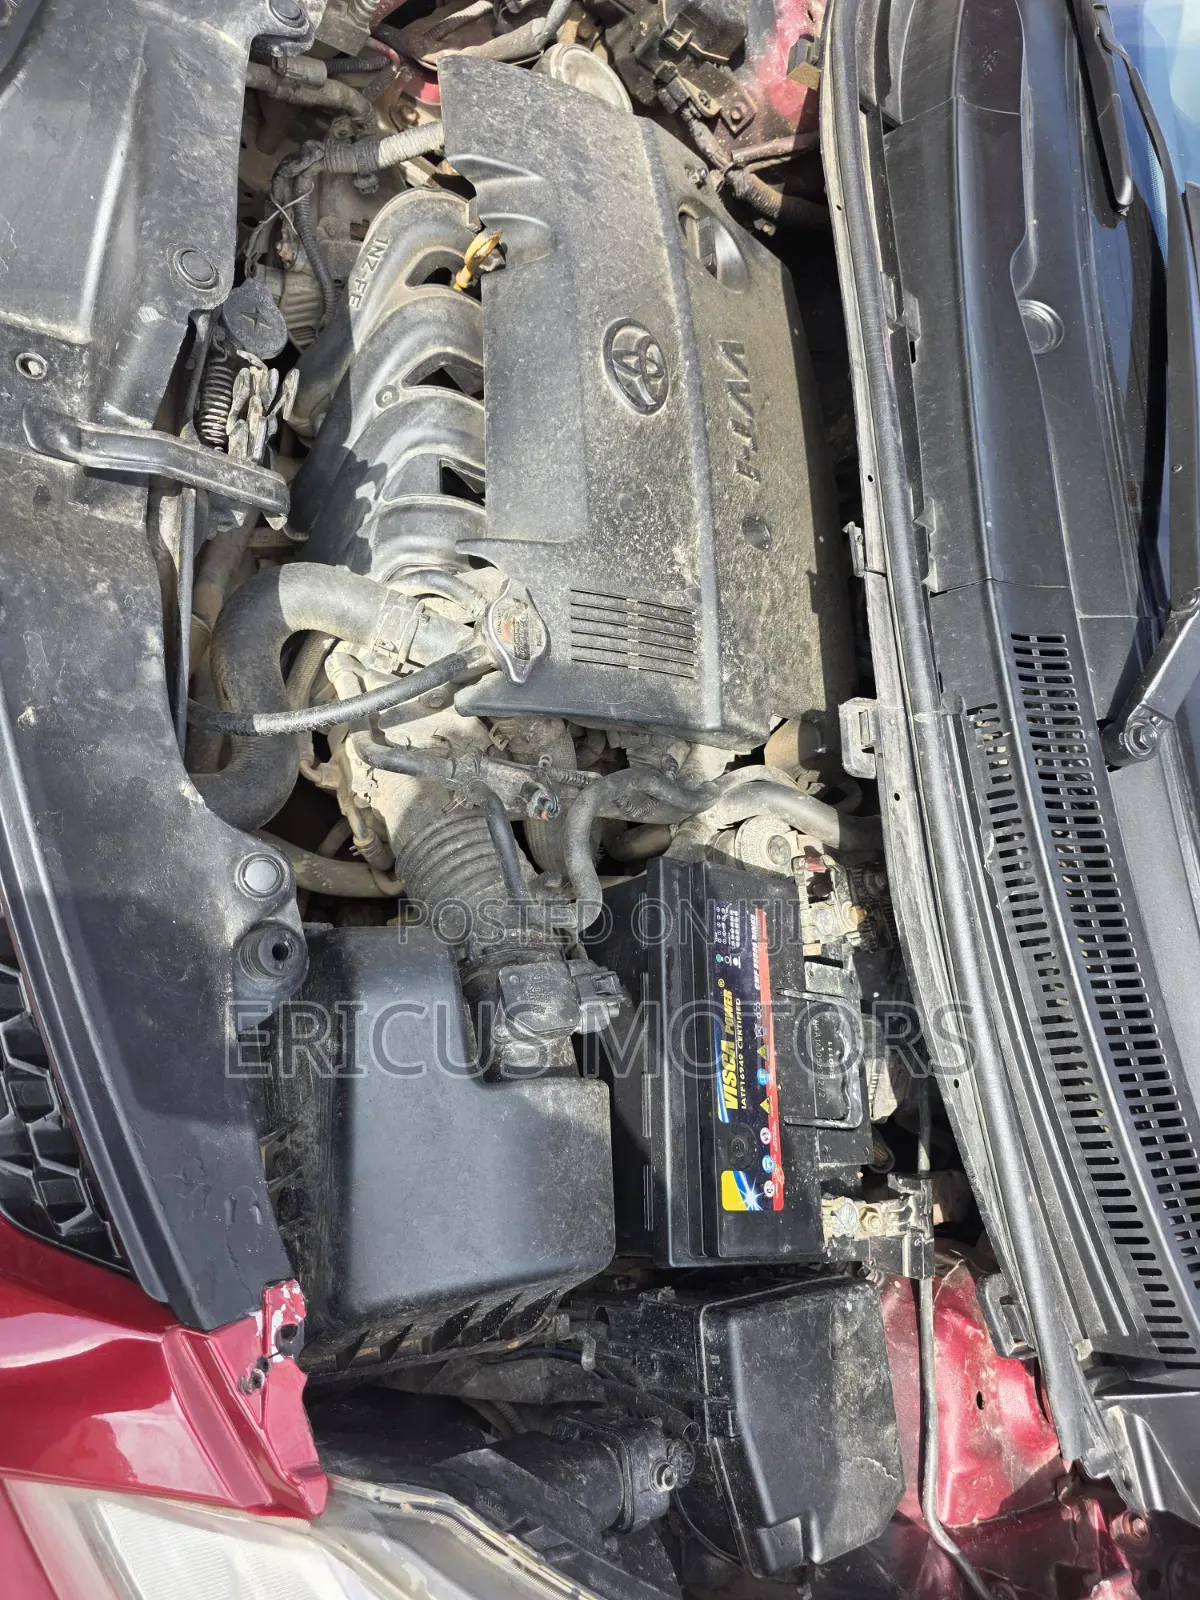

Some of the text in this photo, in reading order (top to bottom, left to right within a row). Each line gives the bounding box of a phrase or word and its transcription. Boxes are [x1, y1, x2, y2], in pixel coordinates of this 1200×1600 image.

[349, 238, 389, 309] 1NZ-FE
[720, 989, 738, 1110] VISCA POWER
[735, 998, 747, 1109] IATF16949 CERTIFIED
